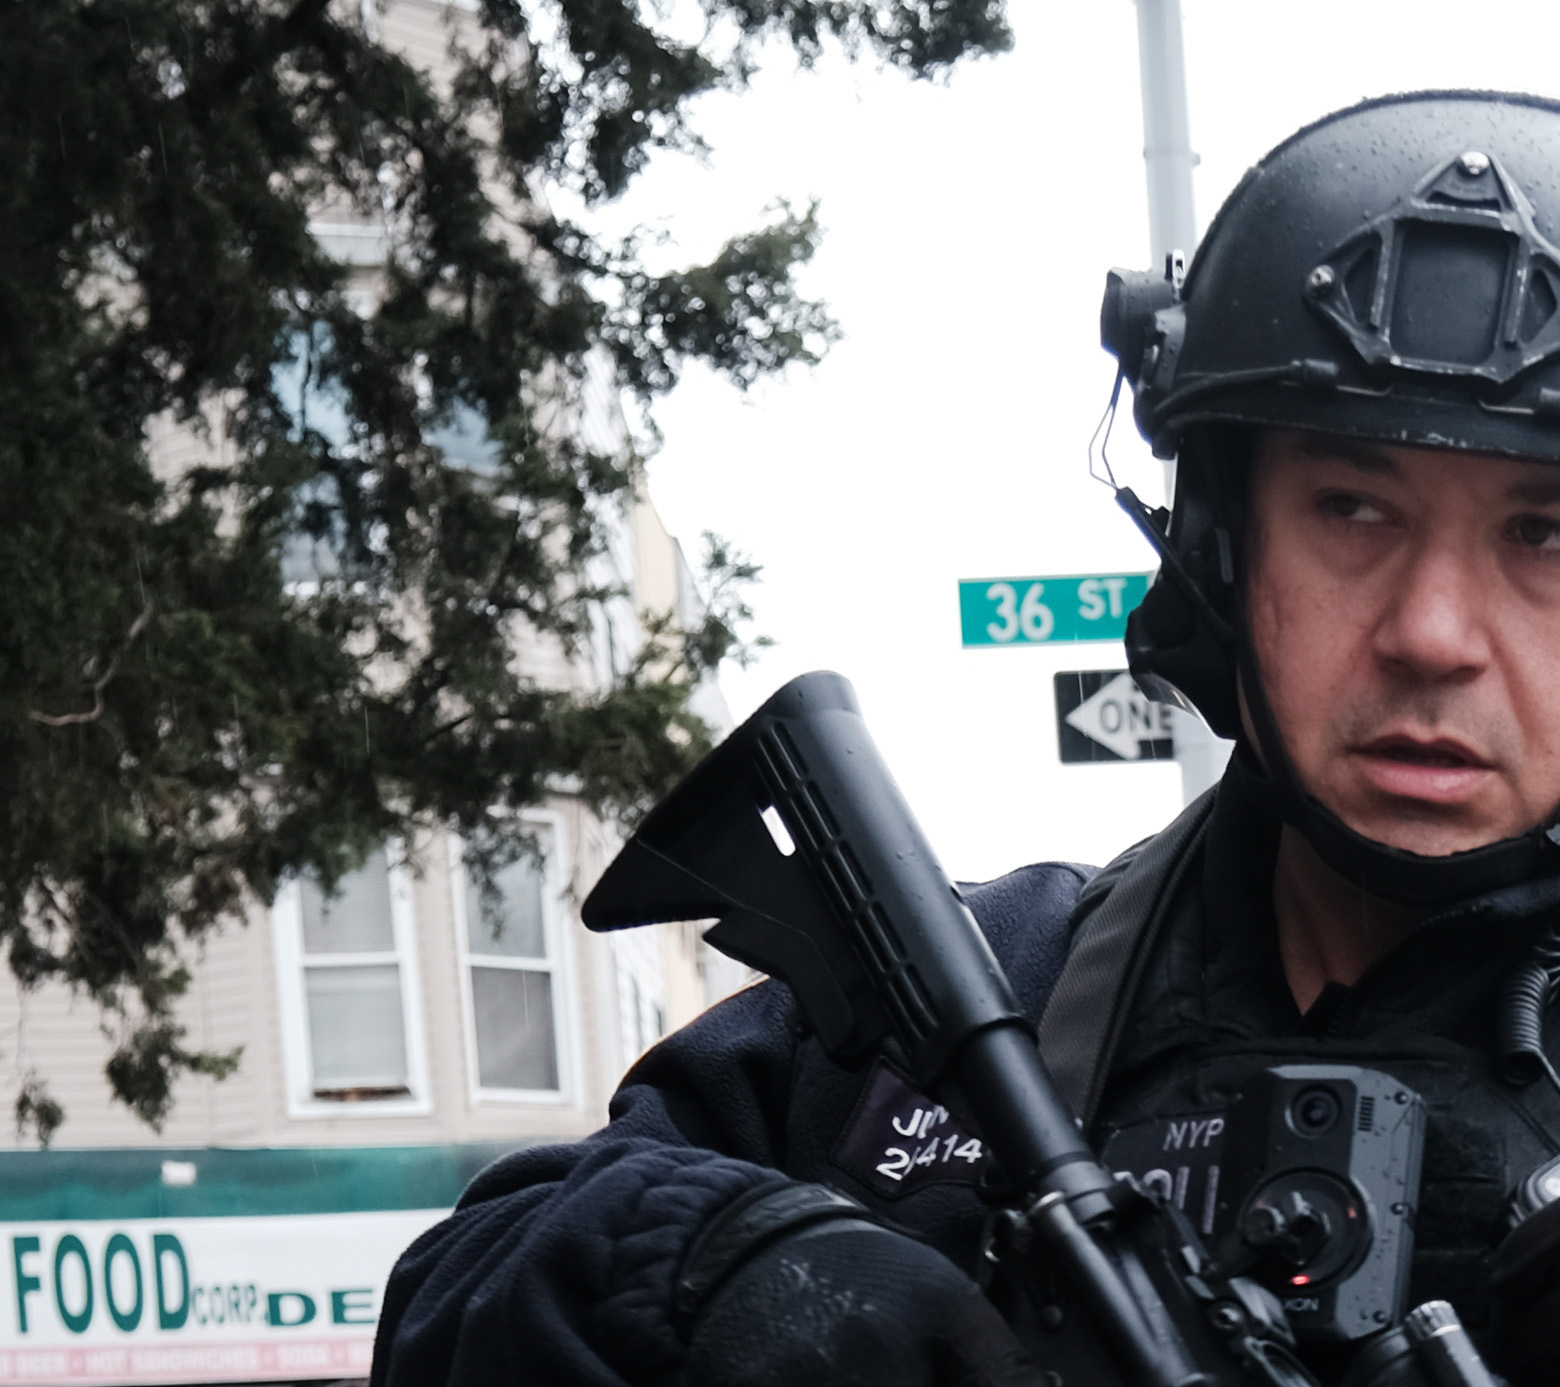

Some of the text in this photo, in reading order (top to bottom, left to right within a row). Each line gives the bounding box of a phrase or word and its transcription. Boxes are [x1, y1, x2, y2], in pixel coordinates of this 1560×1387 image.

[986, 578, 1128, 643] 36 ST
[1099, 699, 1173, 735] ONE
[1162, 1118, 1225, 1150] NYP
[13, 1234, 190, 1334] FOOD
[266, 1289, 377, 1327] DE
